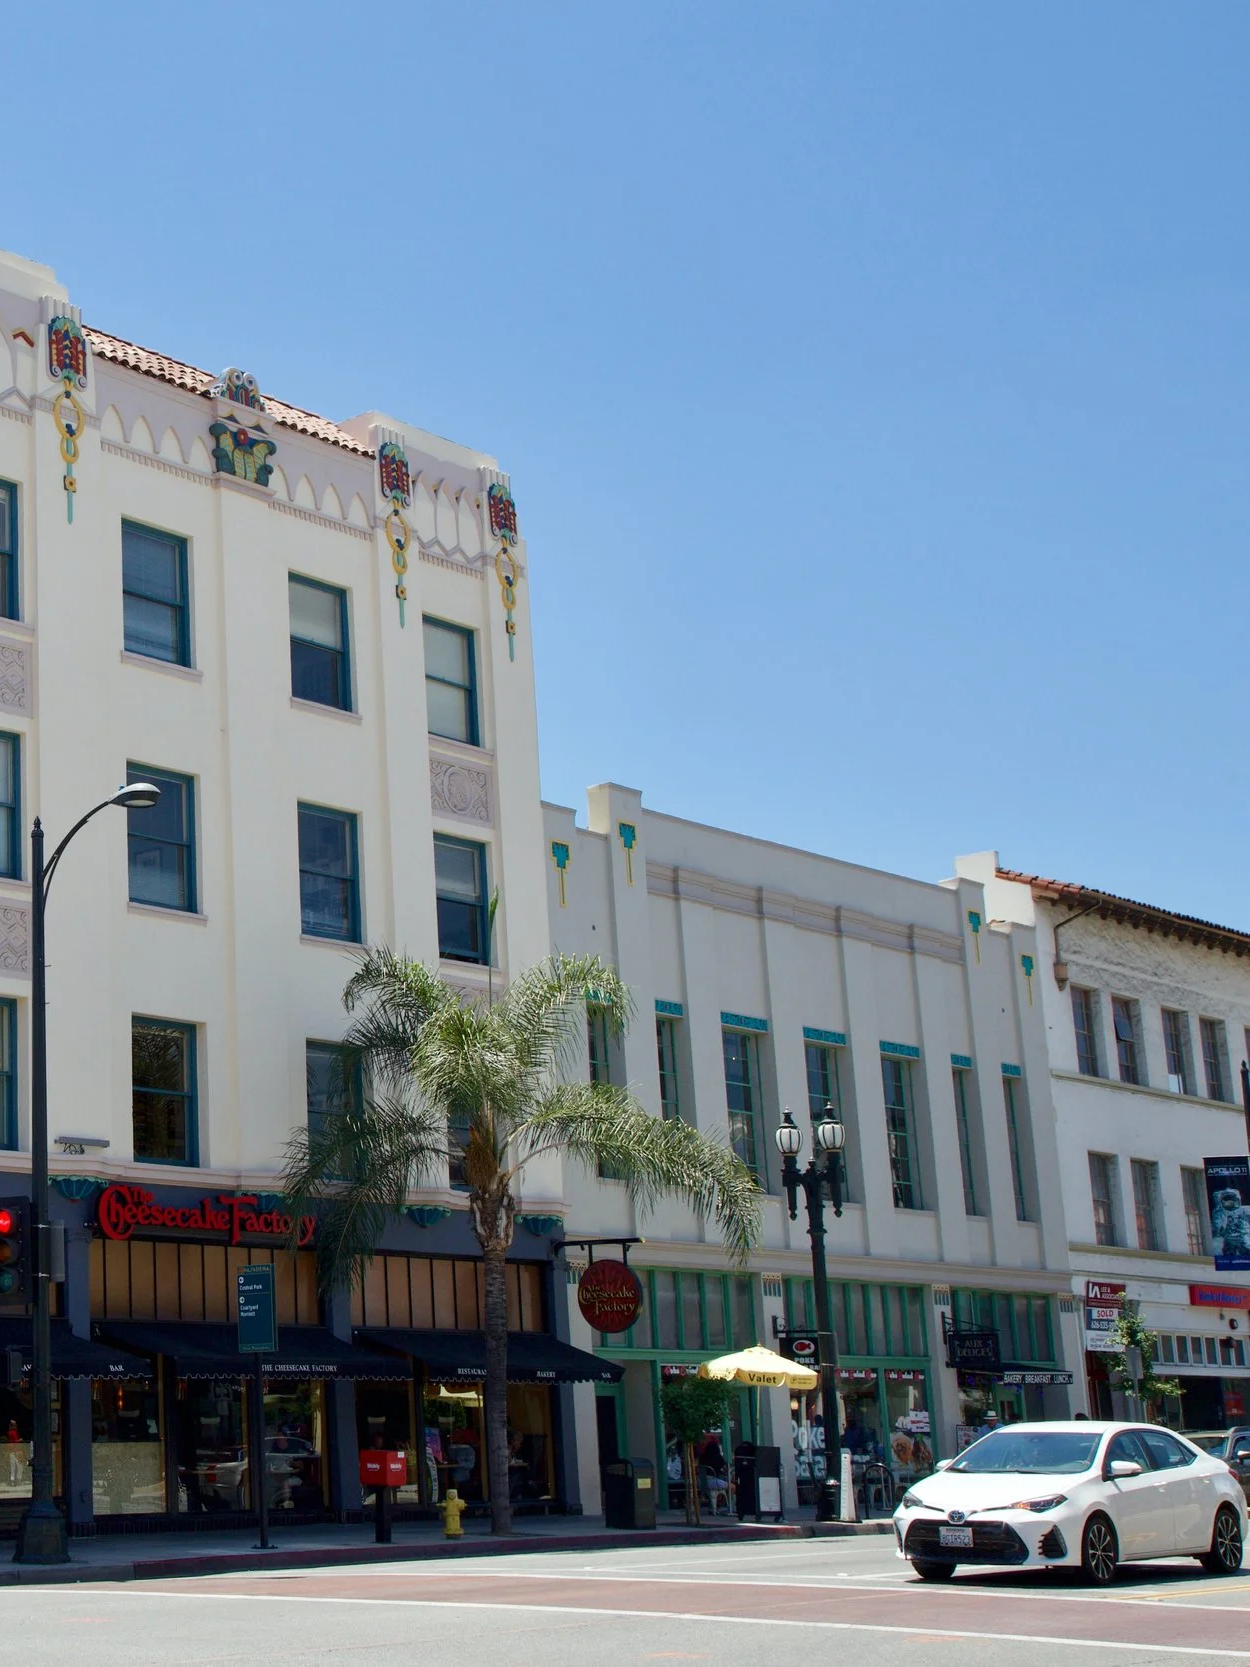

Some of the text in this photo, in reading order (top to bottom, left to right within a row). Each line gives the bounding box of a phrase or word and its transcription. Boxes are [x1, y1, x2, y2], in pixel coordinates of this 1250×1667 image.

[129, 1186, 155, 1203] The
[99, 1184, 317, 1246] Cheesecake Factoy
[579, 1285, 635, 1304] Cheesecake
[590, 1298, 636, 1315] Factory
[957, 1348, 992, 1356] DELICES
[311, 1364, 338, 1372] FACTORY
[536, 1370, 556, 1378] BAKERY
[748, 1373, 777, 1383] Valet
[1004, 1374, 1069, 1384] BAKERY BREAKFAST LUNCH
